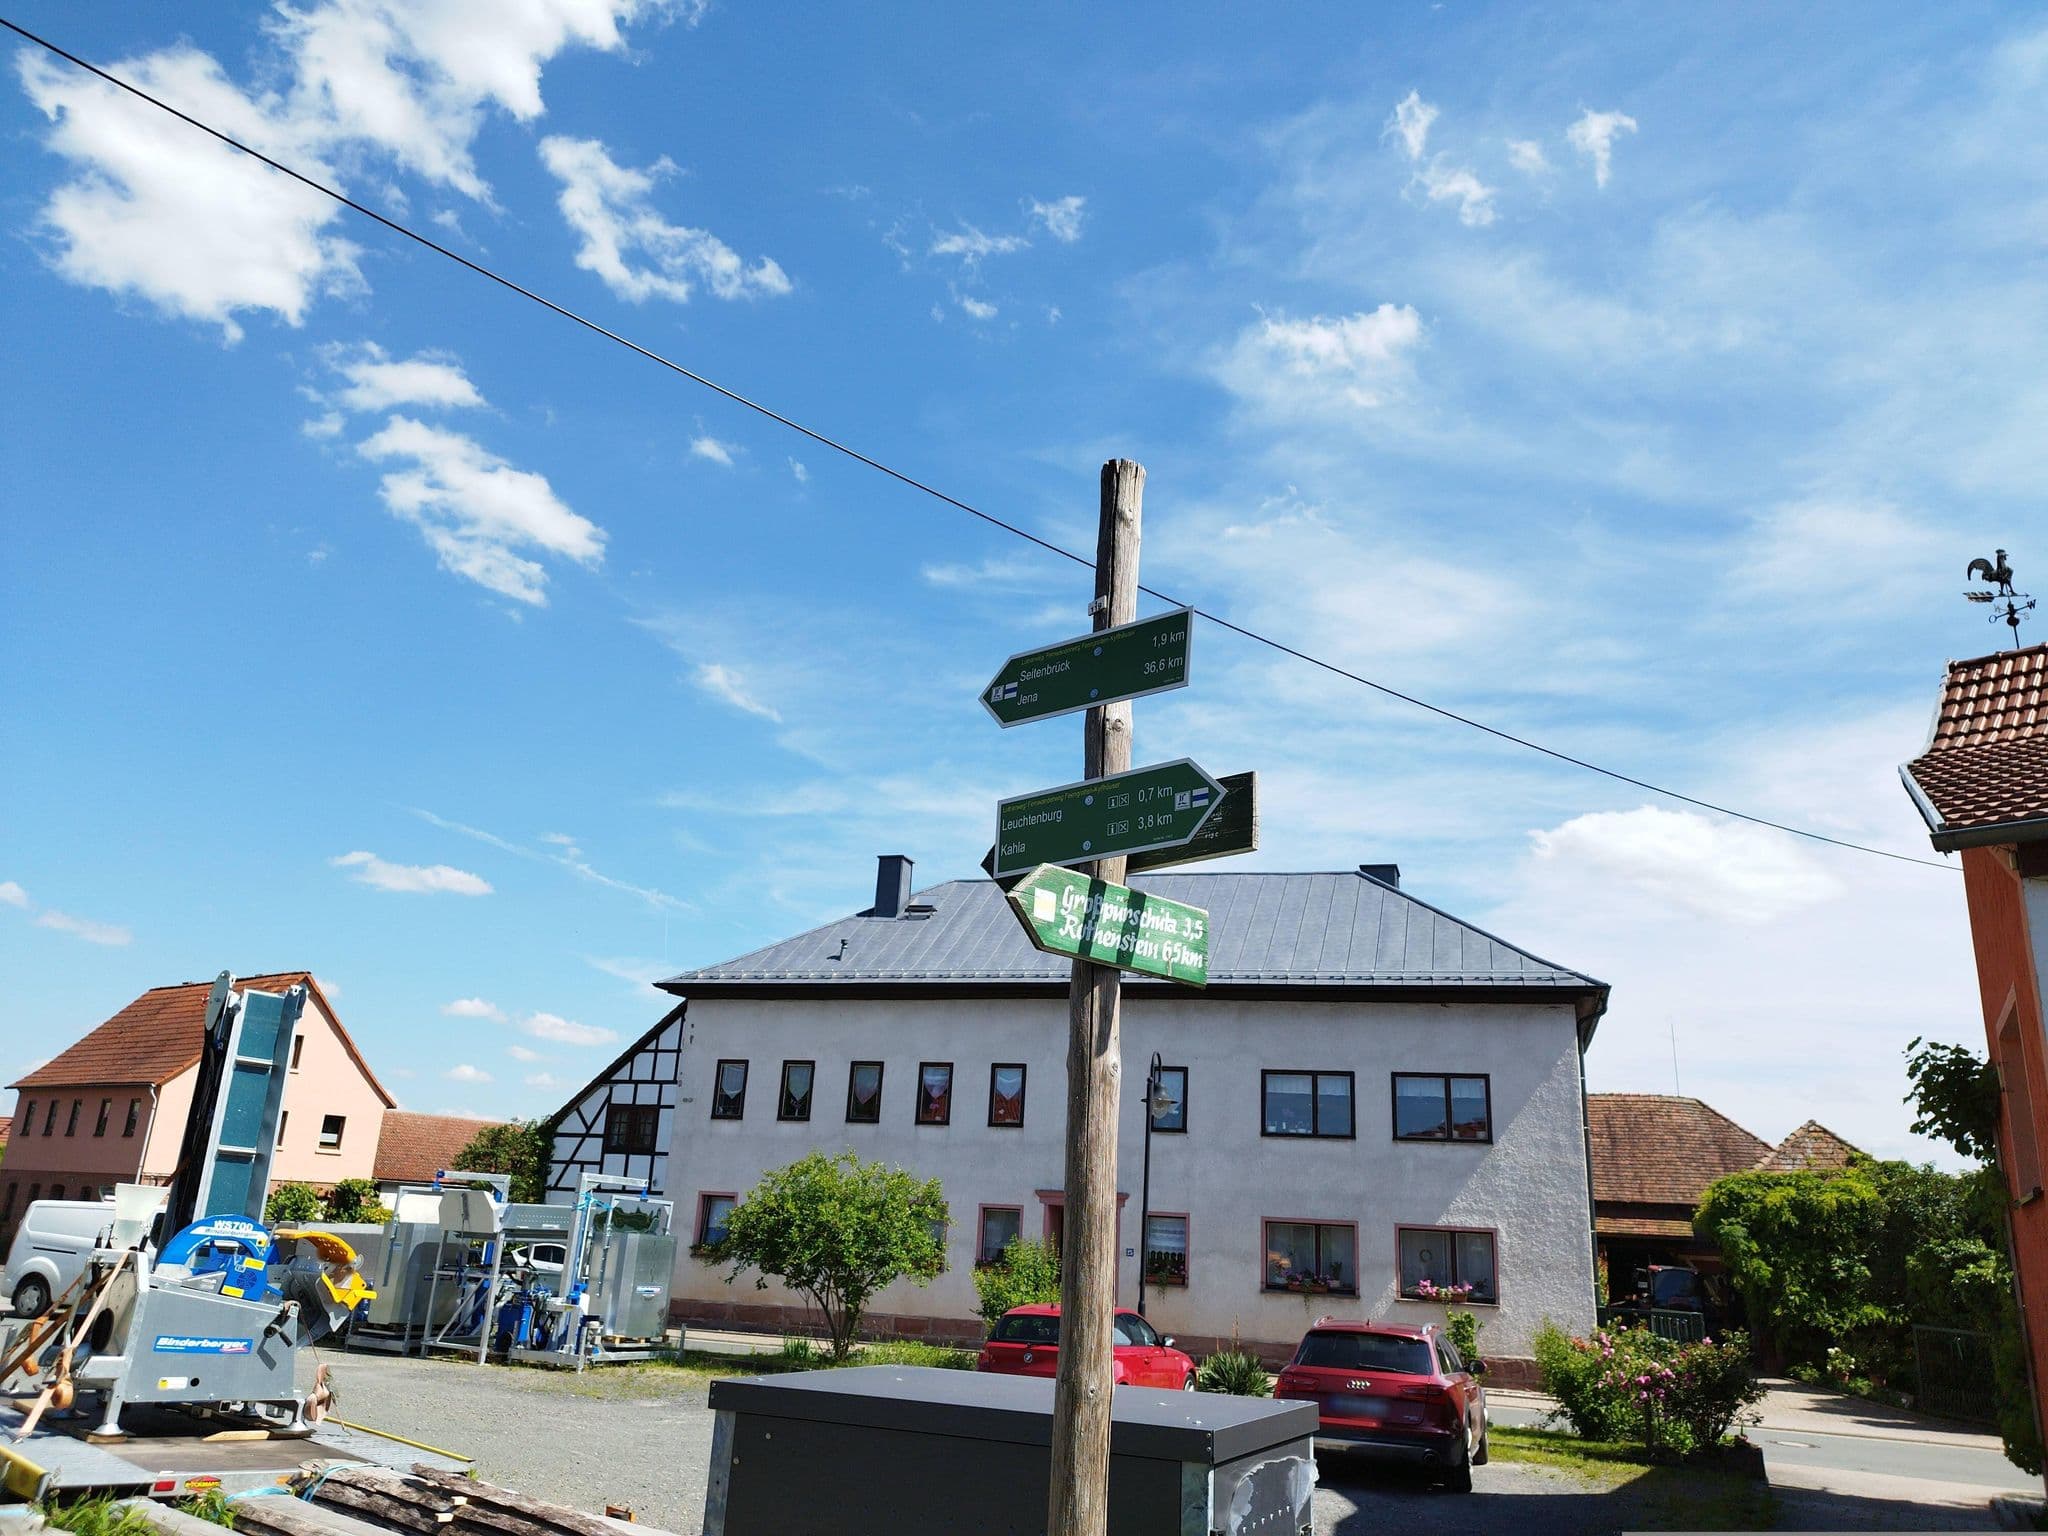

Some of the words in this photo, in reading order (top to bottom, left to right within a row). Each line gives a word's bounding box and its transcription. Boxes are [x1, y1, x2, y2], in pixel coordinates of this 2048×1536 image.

[1019, 659, 1071, 682] Seitenbrück
[1152, 632, 1168, 648] 1,9
[1170, 631, 1185, 643] km
[1016, 693, 1038, 706] Jena
[1143, 658, 1166, 675] 36,6
[1168, 656, 1183, 669] km
[1001, 809, 1063, 831] Leuchtenburg
[1138, 787, 1154, 803] 0,7
[1157, 786, 1173, 798] km
[1000, 841, 1026, 857] Kahla
[1137, 814, 1154, 831] 3,8
[1156, 813, 1173, 826] km
[214, 1220, 254, 1231] WS700
[156, 1337, 248, 1349] Binderberger
